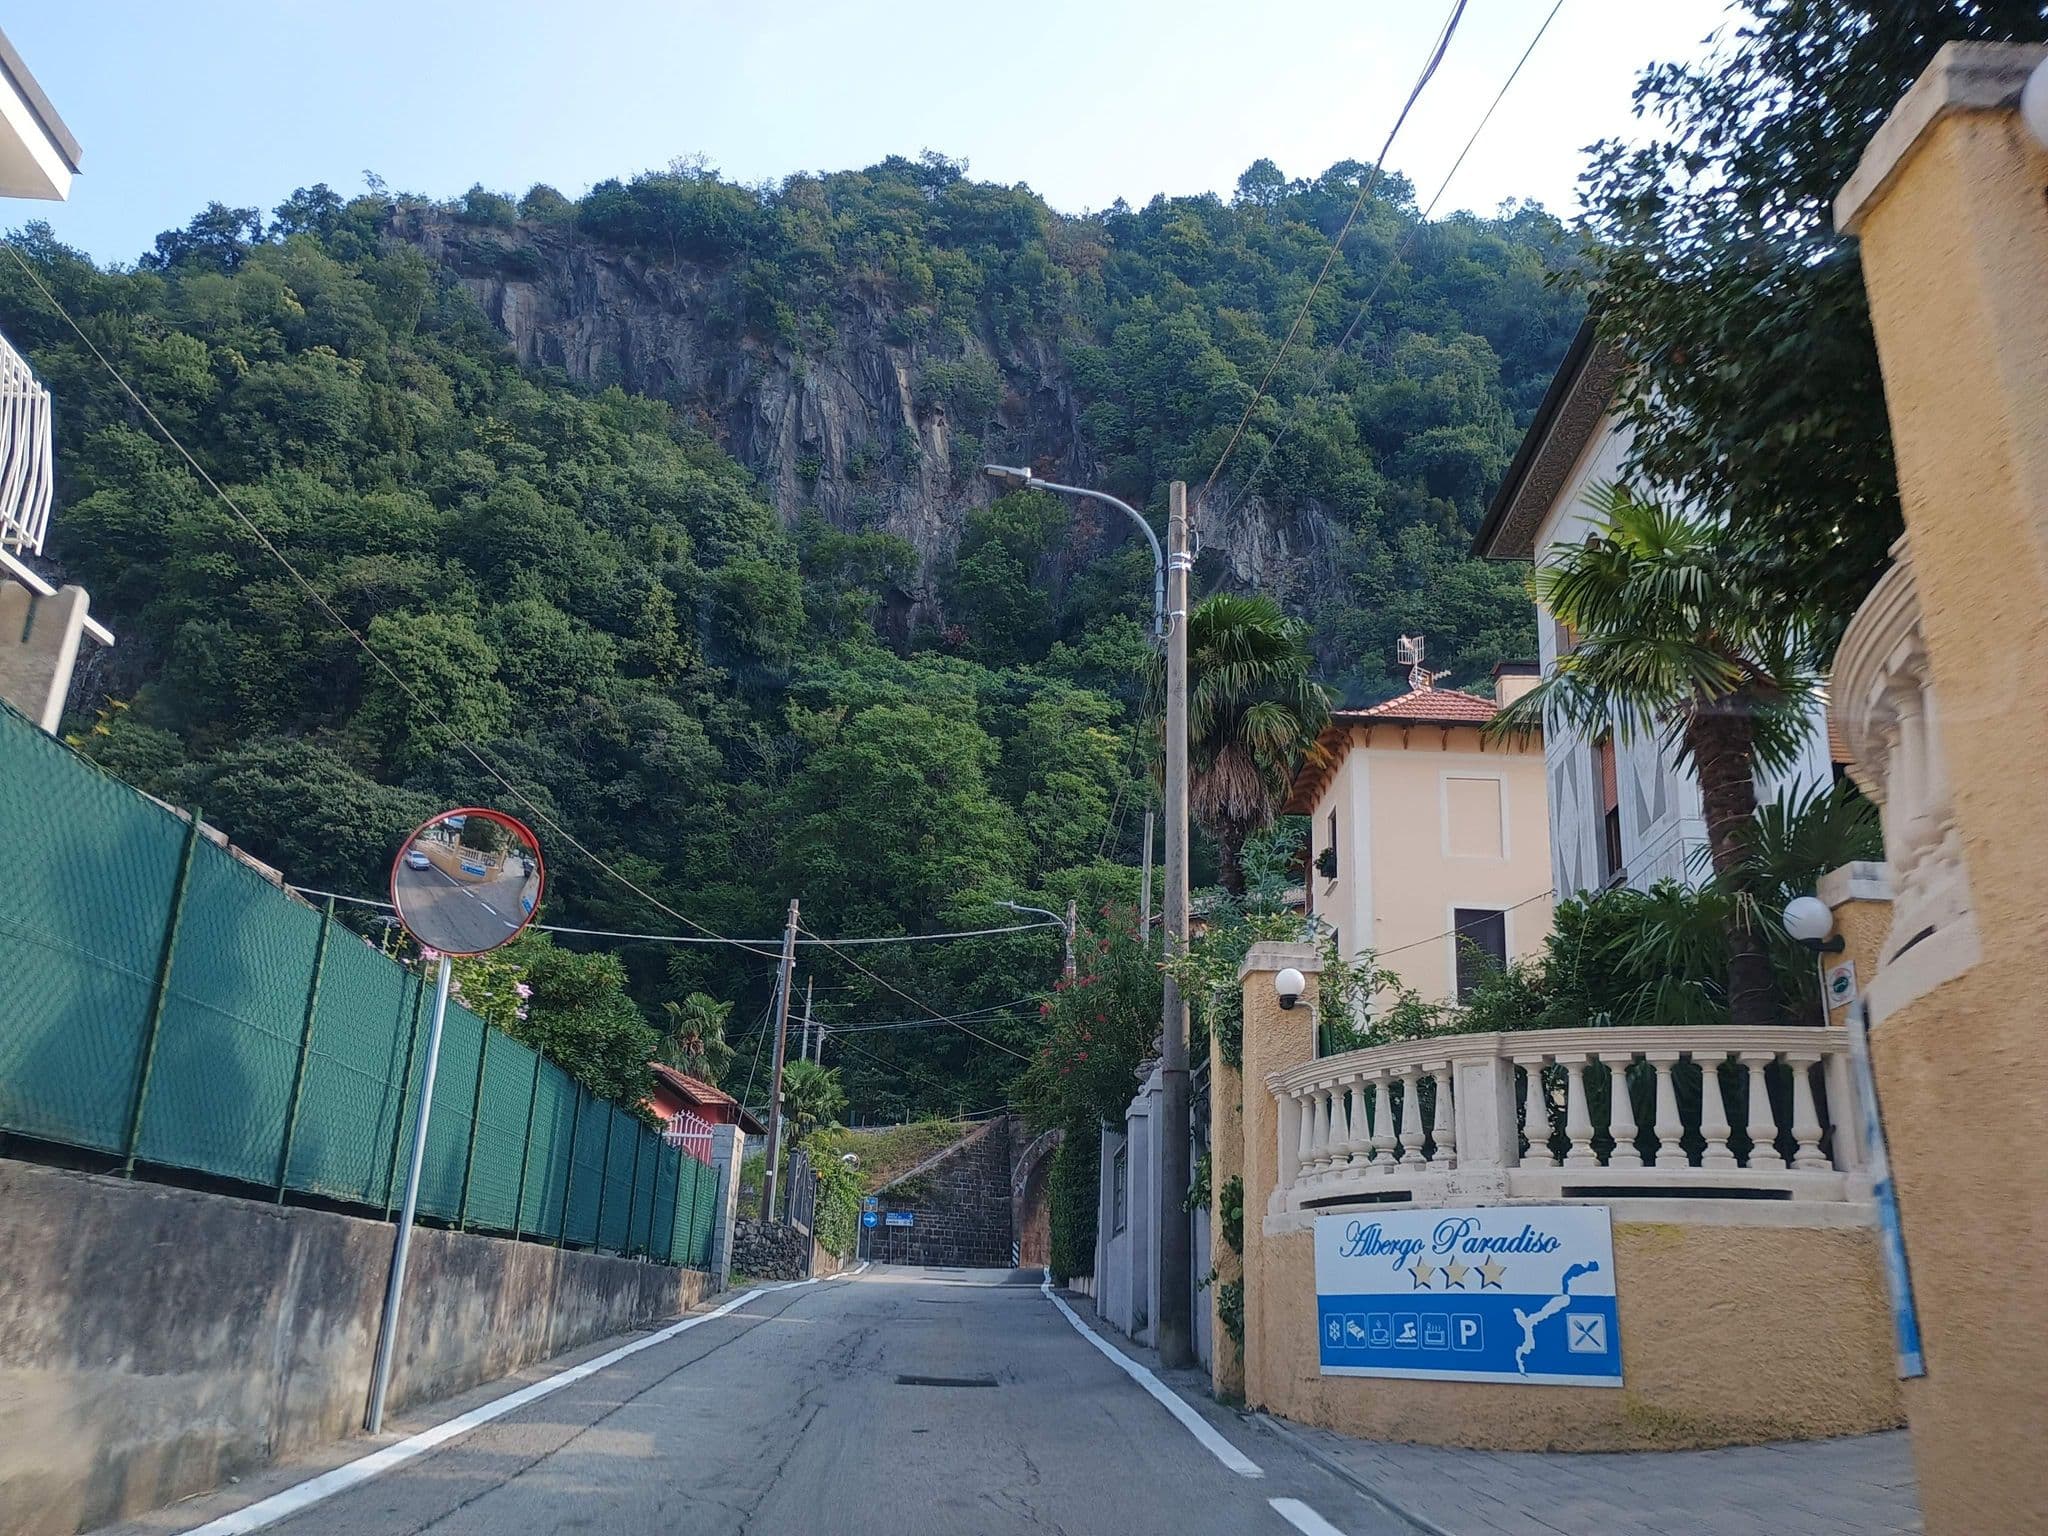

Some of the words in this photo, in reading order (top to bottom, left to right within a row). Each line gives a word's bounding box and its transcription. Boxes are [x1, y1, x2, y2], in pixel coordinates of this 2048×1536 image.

[1339, 1220, 1425, 1271] Albergo
[1432, 1217, 1561, 1255] Paradiso
[1460, 1319, 1478, 1346] P
